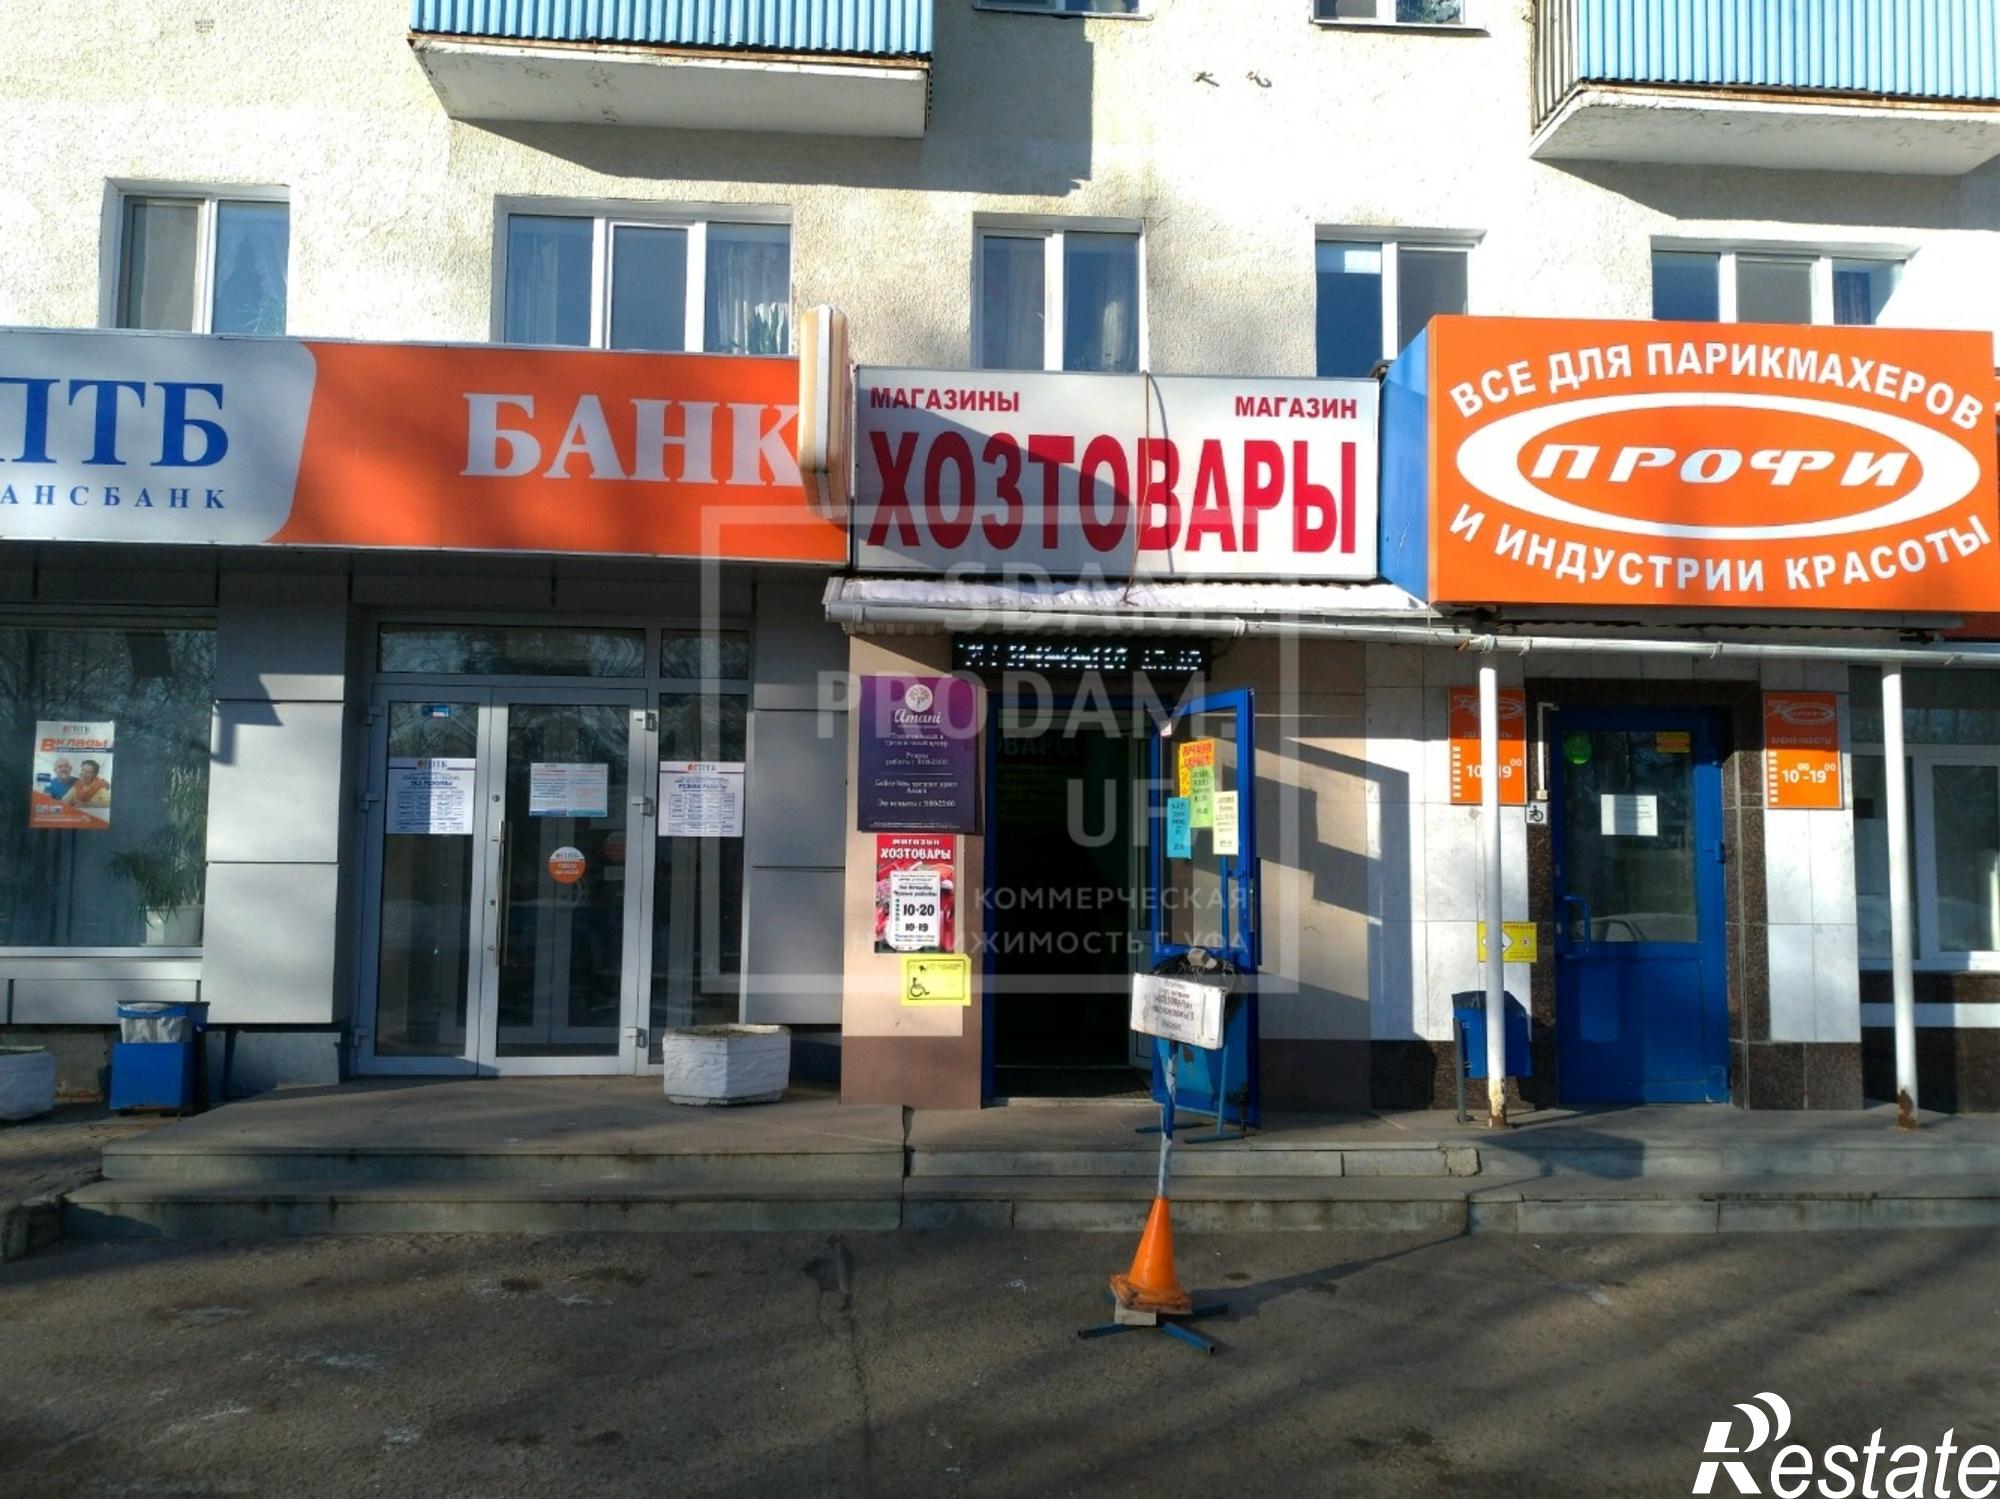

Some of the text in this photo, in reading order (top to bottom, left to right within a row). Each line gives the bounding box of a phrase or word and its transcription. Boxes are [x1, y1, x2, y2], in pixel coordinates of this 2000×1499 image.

[870, 387, 1020, 412] МАГАЗИНЫ
[1235, 396, 1357, 419] МАГАЗИН
[1449, 342, 1984, 431] ВСЕ ДЛЯ ПАРИКМАХЕРОВ
[460, 392, 803, 488] БАНК
[1530, 443, 1911, 488] ПРОФИ
[867, 430, 1356, 555] ХОЗТОВАРЫ
[1449, 503, 1990, 592] И ИНДУСТРИИ КРАСОТЫ
[880, 848, 952, 860] ХОЗТОВАРЫ
